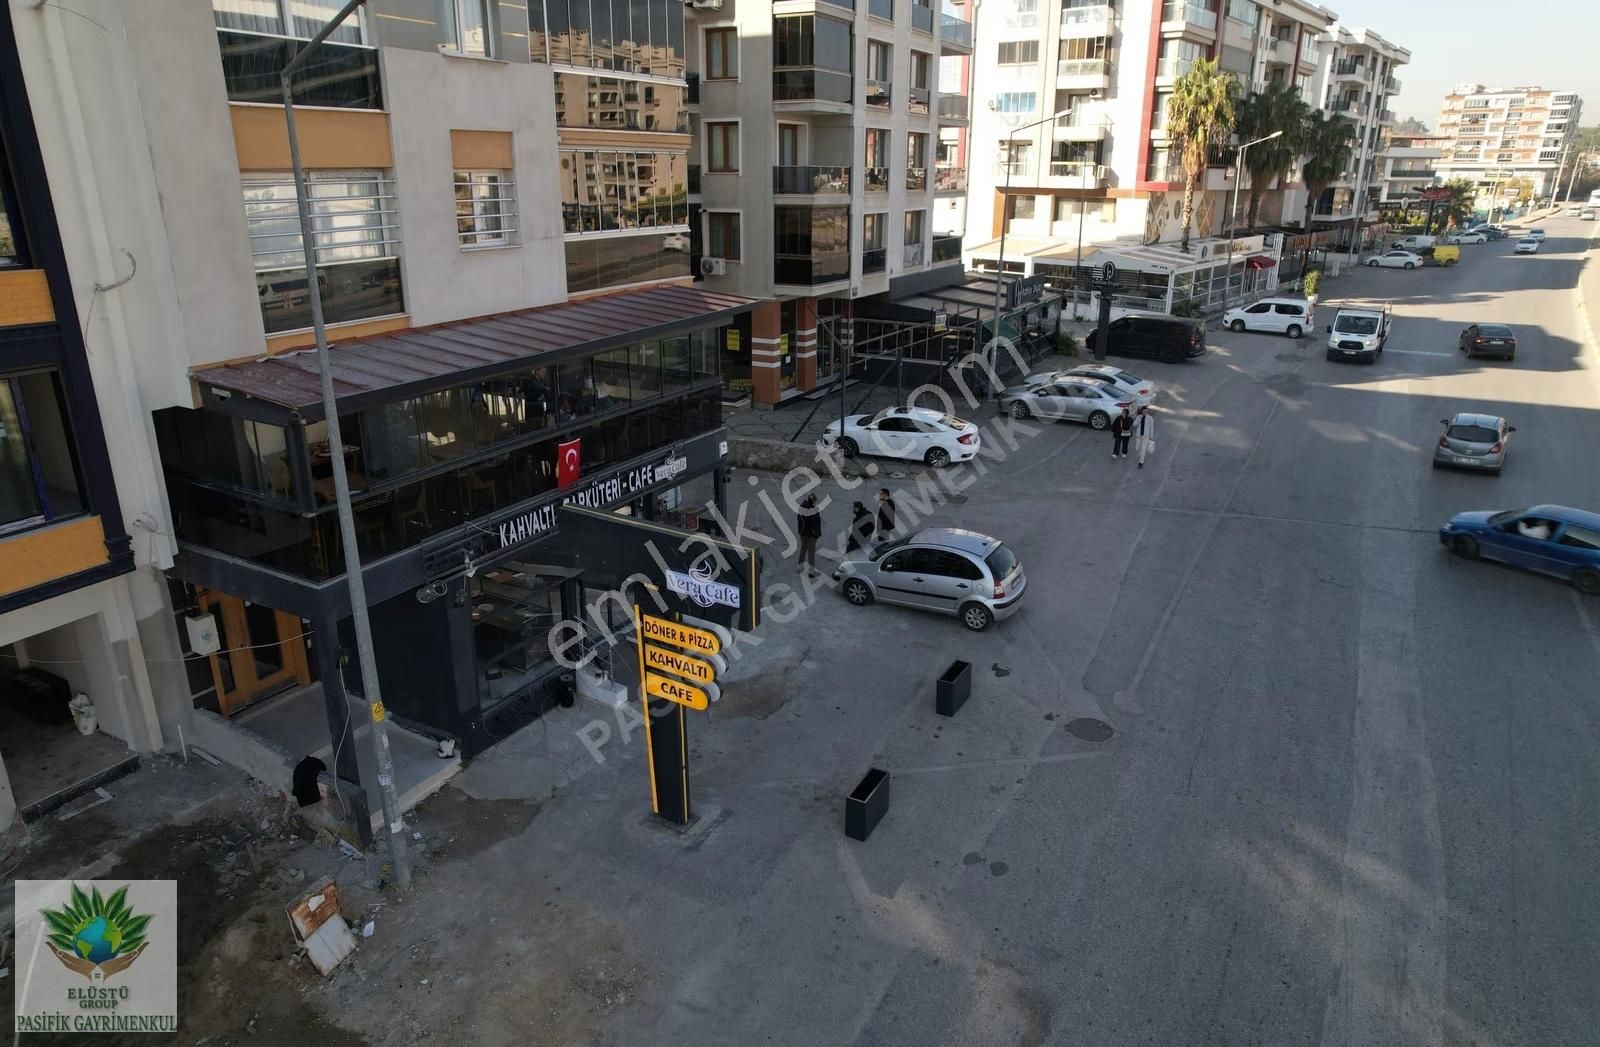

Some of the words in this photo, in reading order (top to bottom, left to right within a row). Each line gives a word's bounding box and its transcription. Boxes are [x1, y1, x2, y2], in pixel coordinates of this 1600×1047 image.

[500, 504, 556, 548] KAHVALTI
[628, 464, 652, 492] CAFE
[668, 574, 702, 595] Vera
[705, 583, 738, 604] Cafe
[645, 620, 677, 640] DÖNER
[689, 632, 714, 651] PİZZA
[650, 650, 707, 678] KAHVALTI
[661, 683, 692, 702] CAFE
